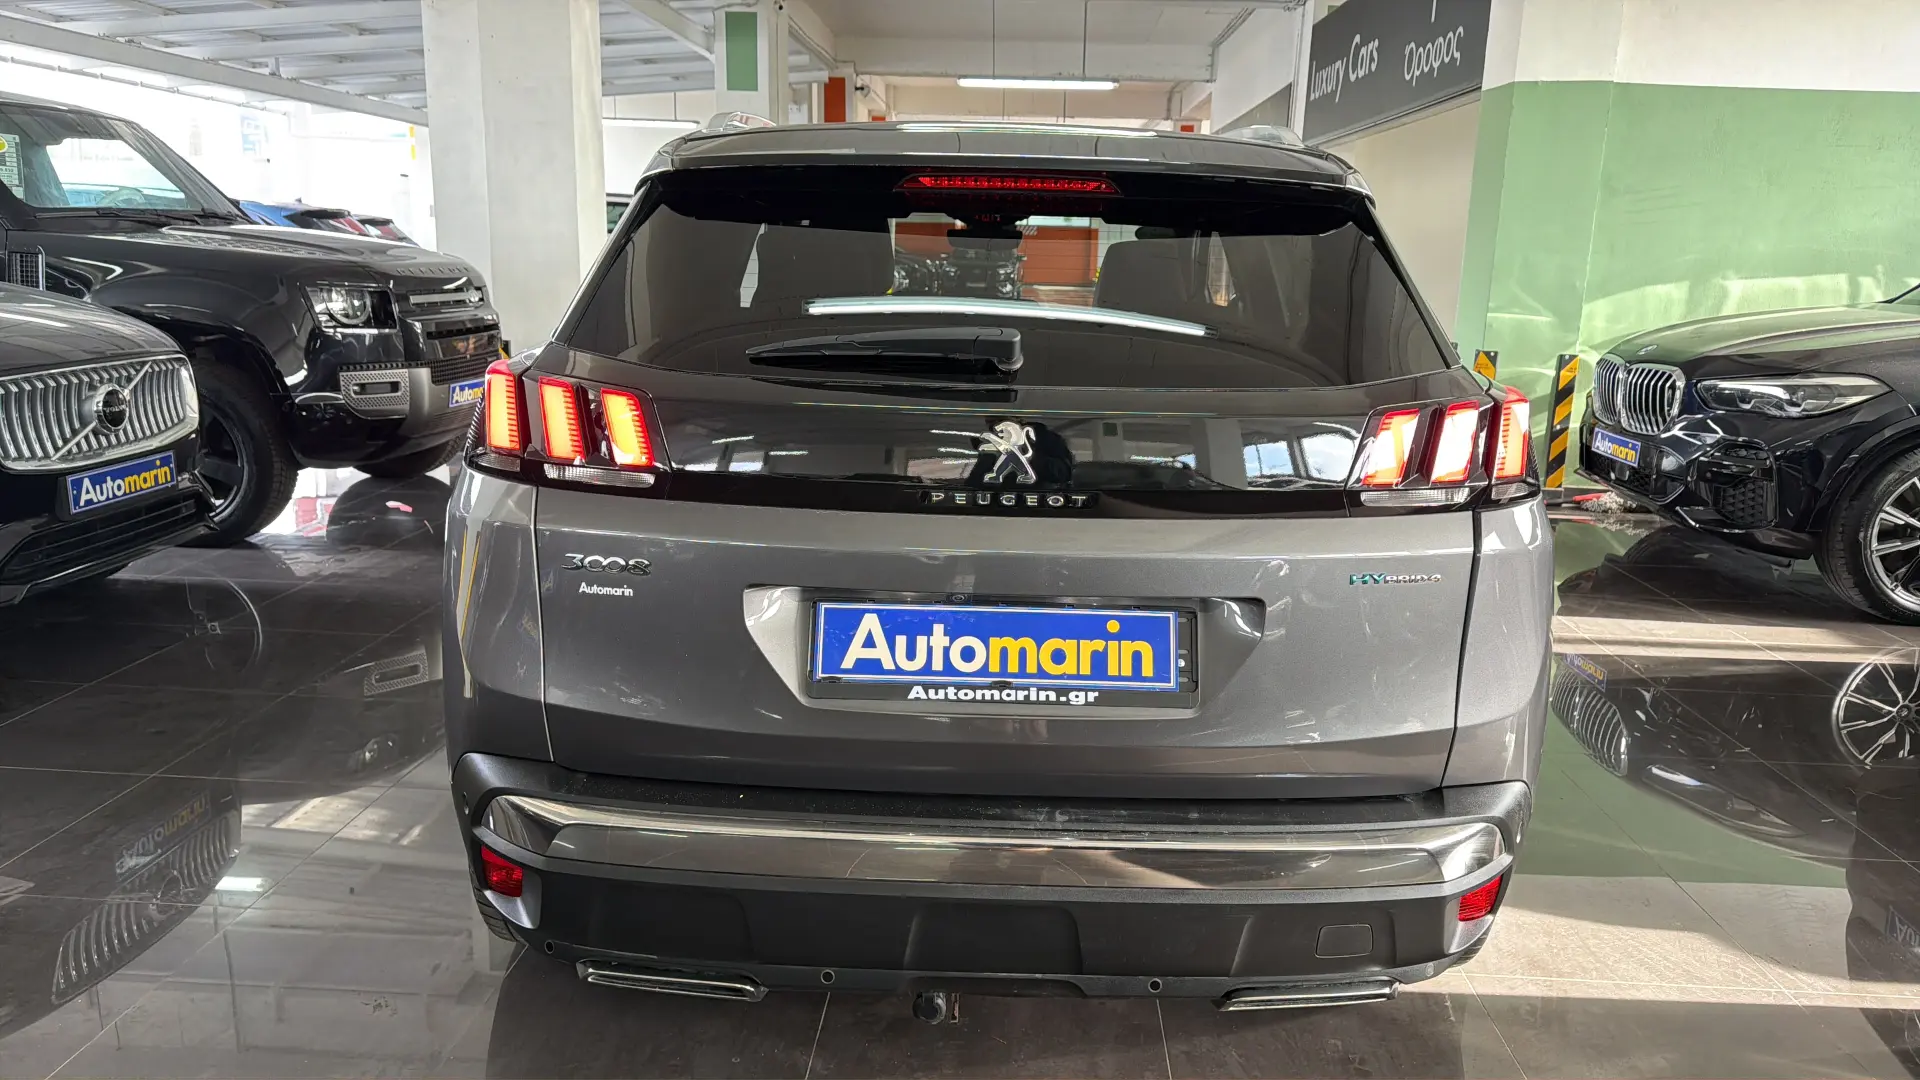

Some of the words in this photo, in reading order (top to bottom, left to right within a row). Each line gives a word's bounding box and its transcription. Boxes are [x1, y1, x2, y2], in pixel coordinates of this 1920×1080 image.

[1310, 57, 1347, 103] Luxury
[1349, 34, 1379, 82] Cars
[1594, 432, 1636, 462] Automarin
[79, 460, 171, 507] Automarin
[931, 493, 1087, 506] PEUGEOT
[561, 553, 651, 576] 3008
[579, 581, 634, 597] Automarin
[840, 613, 1154, 677] Automarin
[907, 685, 1099, 704] Automarin.gr
